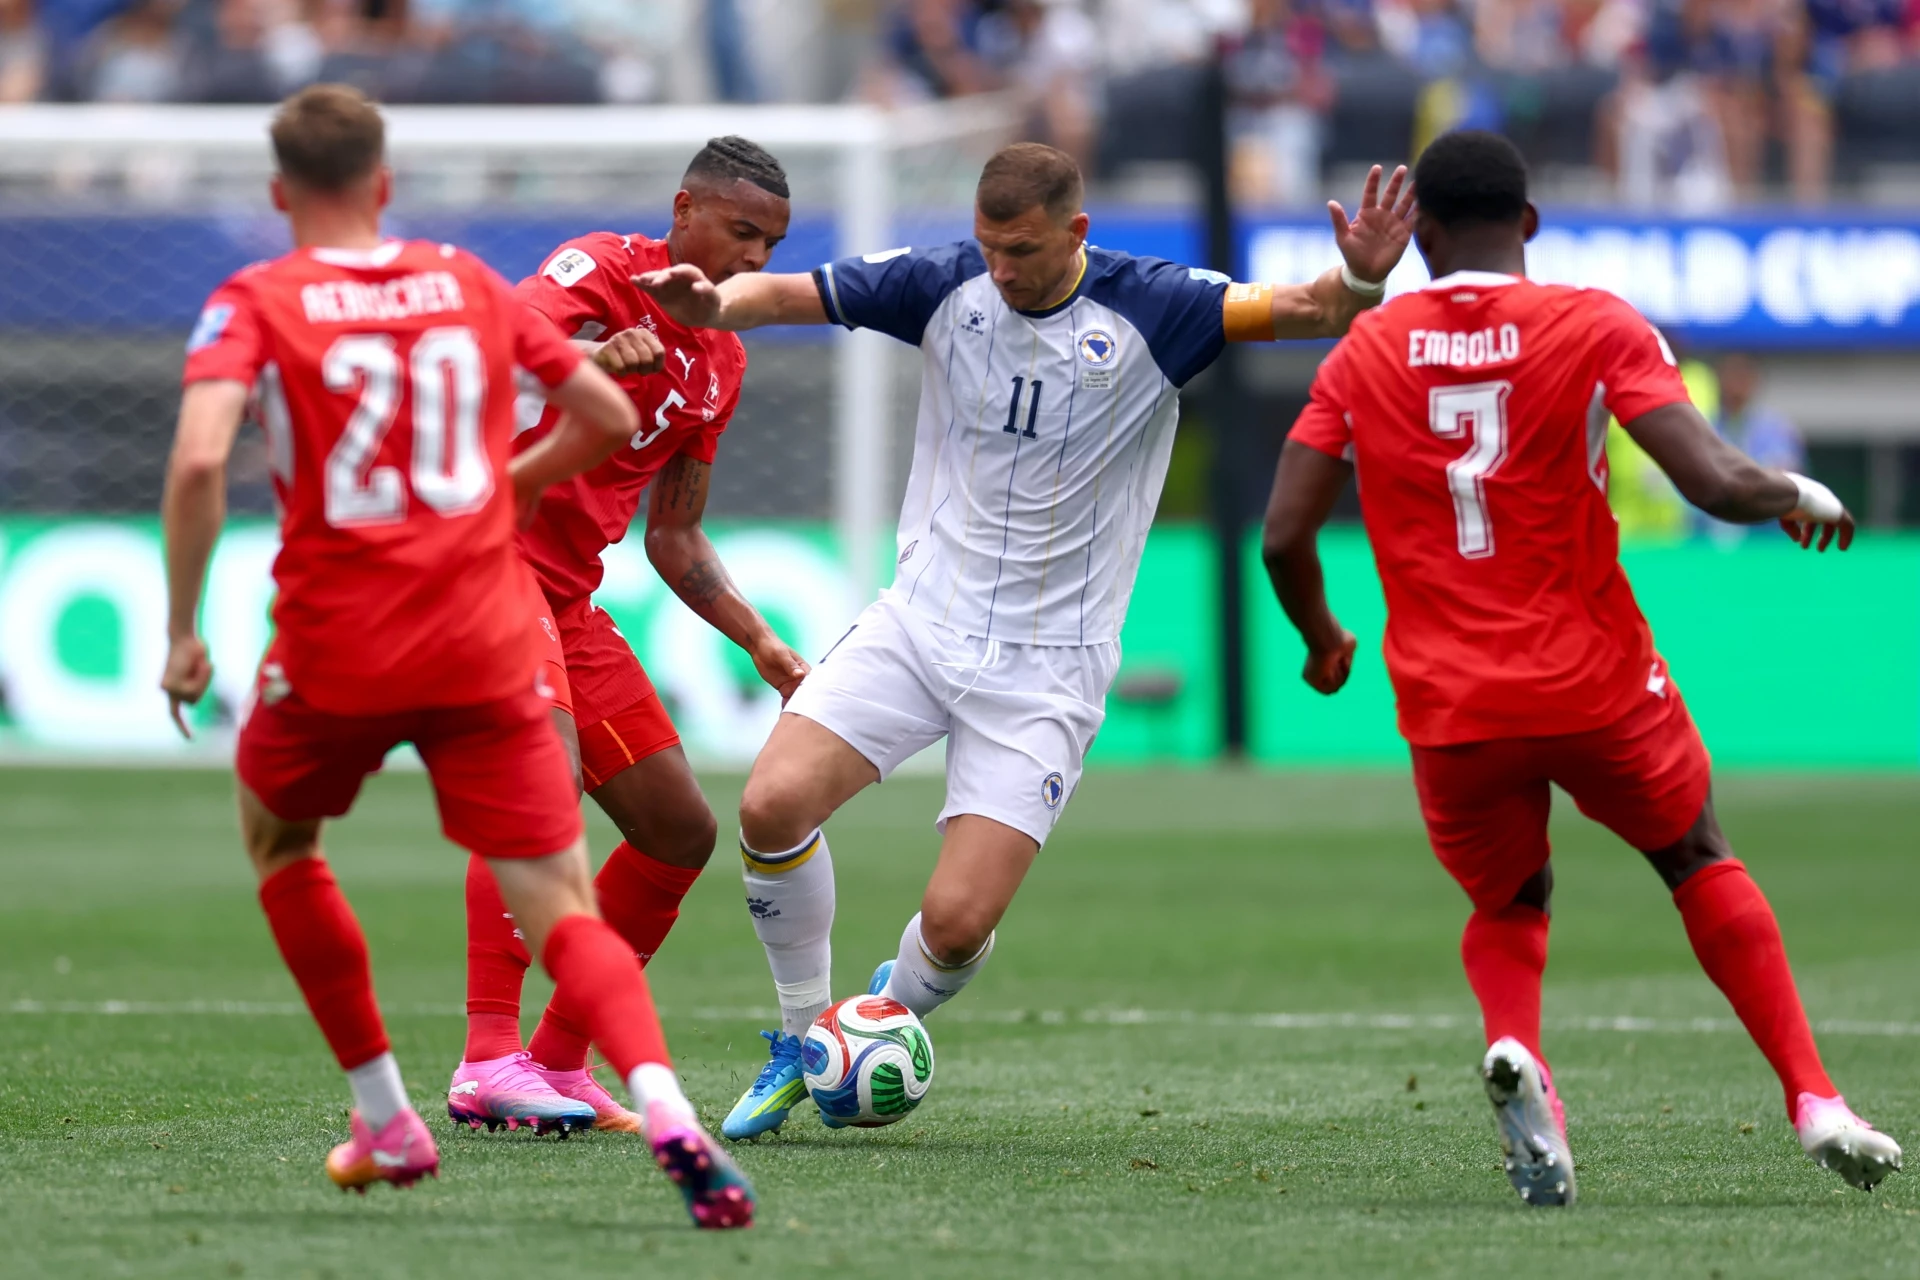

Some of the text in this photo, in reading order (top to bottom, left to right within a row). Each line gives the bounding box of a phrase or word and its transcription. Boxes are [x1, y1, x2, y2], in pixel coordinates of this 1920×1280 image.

[301, 271, 465, 324] AEBISCHER
[1755, 226, 1920, 328] CUP
[1408, 322, 1519, 367] EMBOLO
[321, 325, 496, 529] 20
[630, 388, 687, 450] 5
[1002, 375, 1044, 440] 11
[1429, 379, 1513, 560] 7
